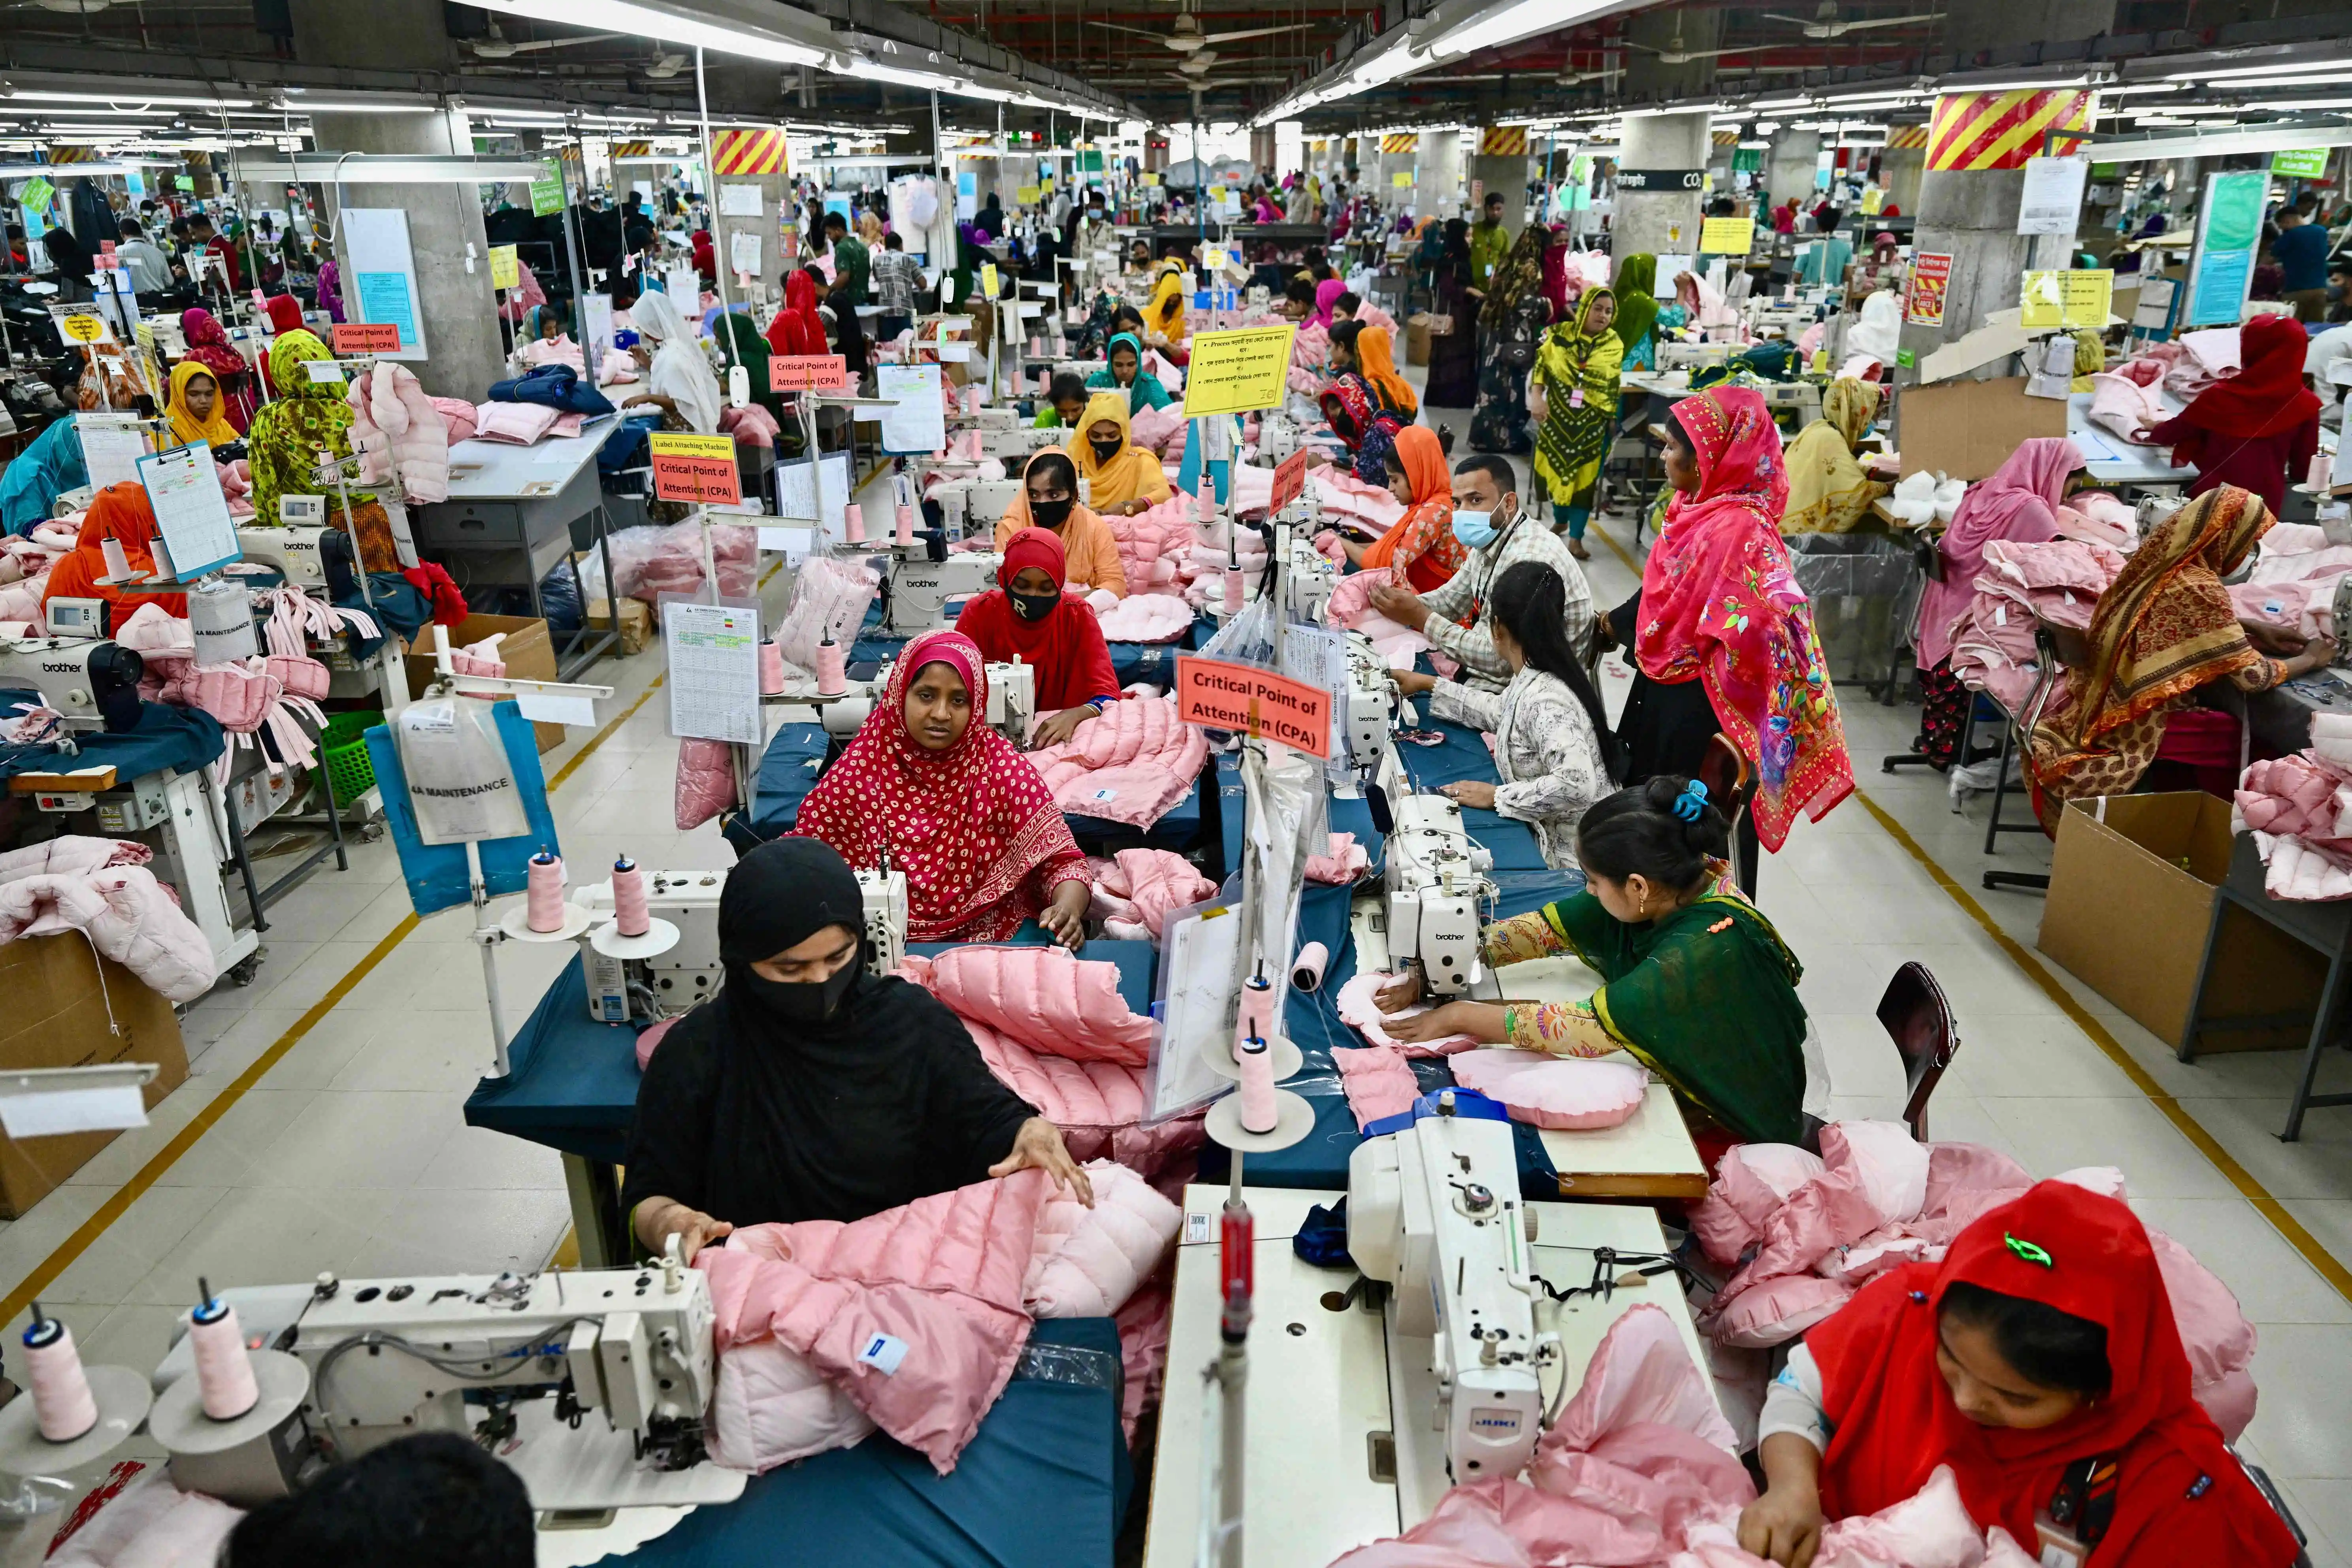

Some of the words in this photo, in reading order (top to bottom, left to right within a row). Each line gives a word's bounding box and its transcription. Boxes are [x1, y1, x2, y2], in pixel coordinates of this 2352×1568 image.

[818, 377, 839, 386] (CPA)
[675, 442, 703, 451] Attaching
[660, 463, 691, 474] Critical
[693, 466, 716, 476] Point
[719, 467, 727, 477] of
[664, 483, 705, 495] Attention
[707, 485, 731, 499] (CPA)
[1013, 597, 1027, 618] R
[206, 620, 251, 636] MAINTENANCE
[43, 662, 81, 673] brother
[1193, 672, 1251, 695] Critical
[1257, 684, 1297, 709] Point
[1300, 702, 1317, 716] of
[1192, 702, 1270, 731] Attention
[1276, 720, 1316, 750] (CPA)
[425, 778, 509, 797] MAINTENANCE
[1476, 1419, 1516, 1428] JUKI
